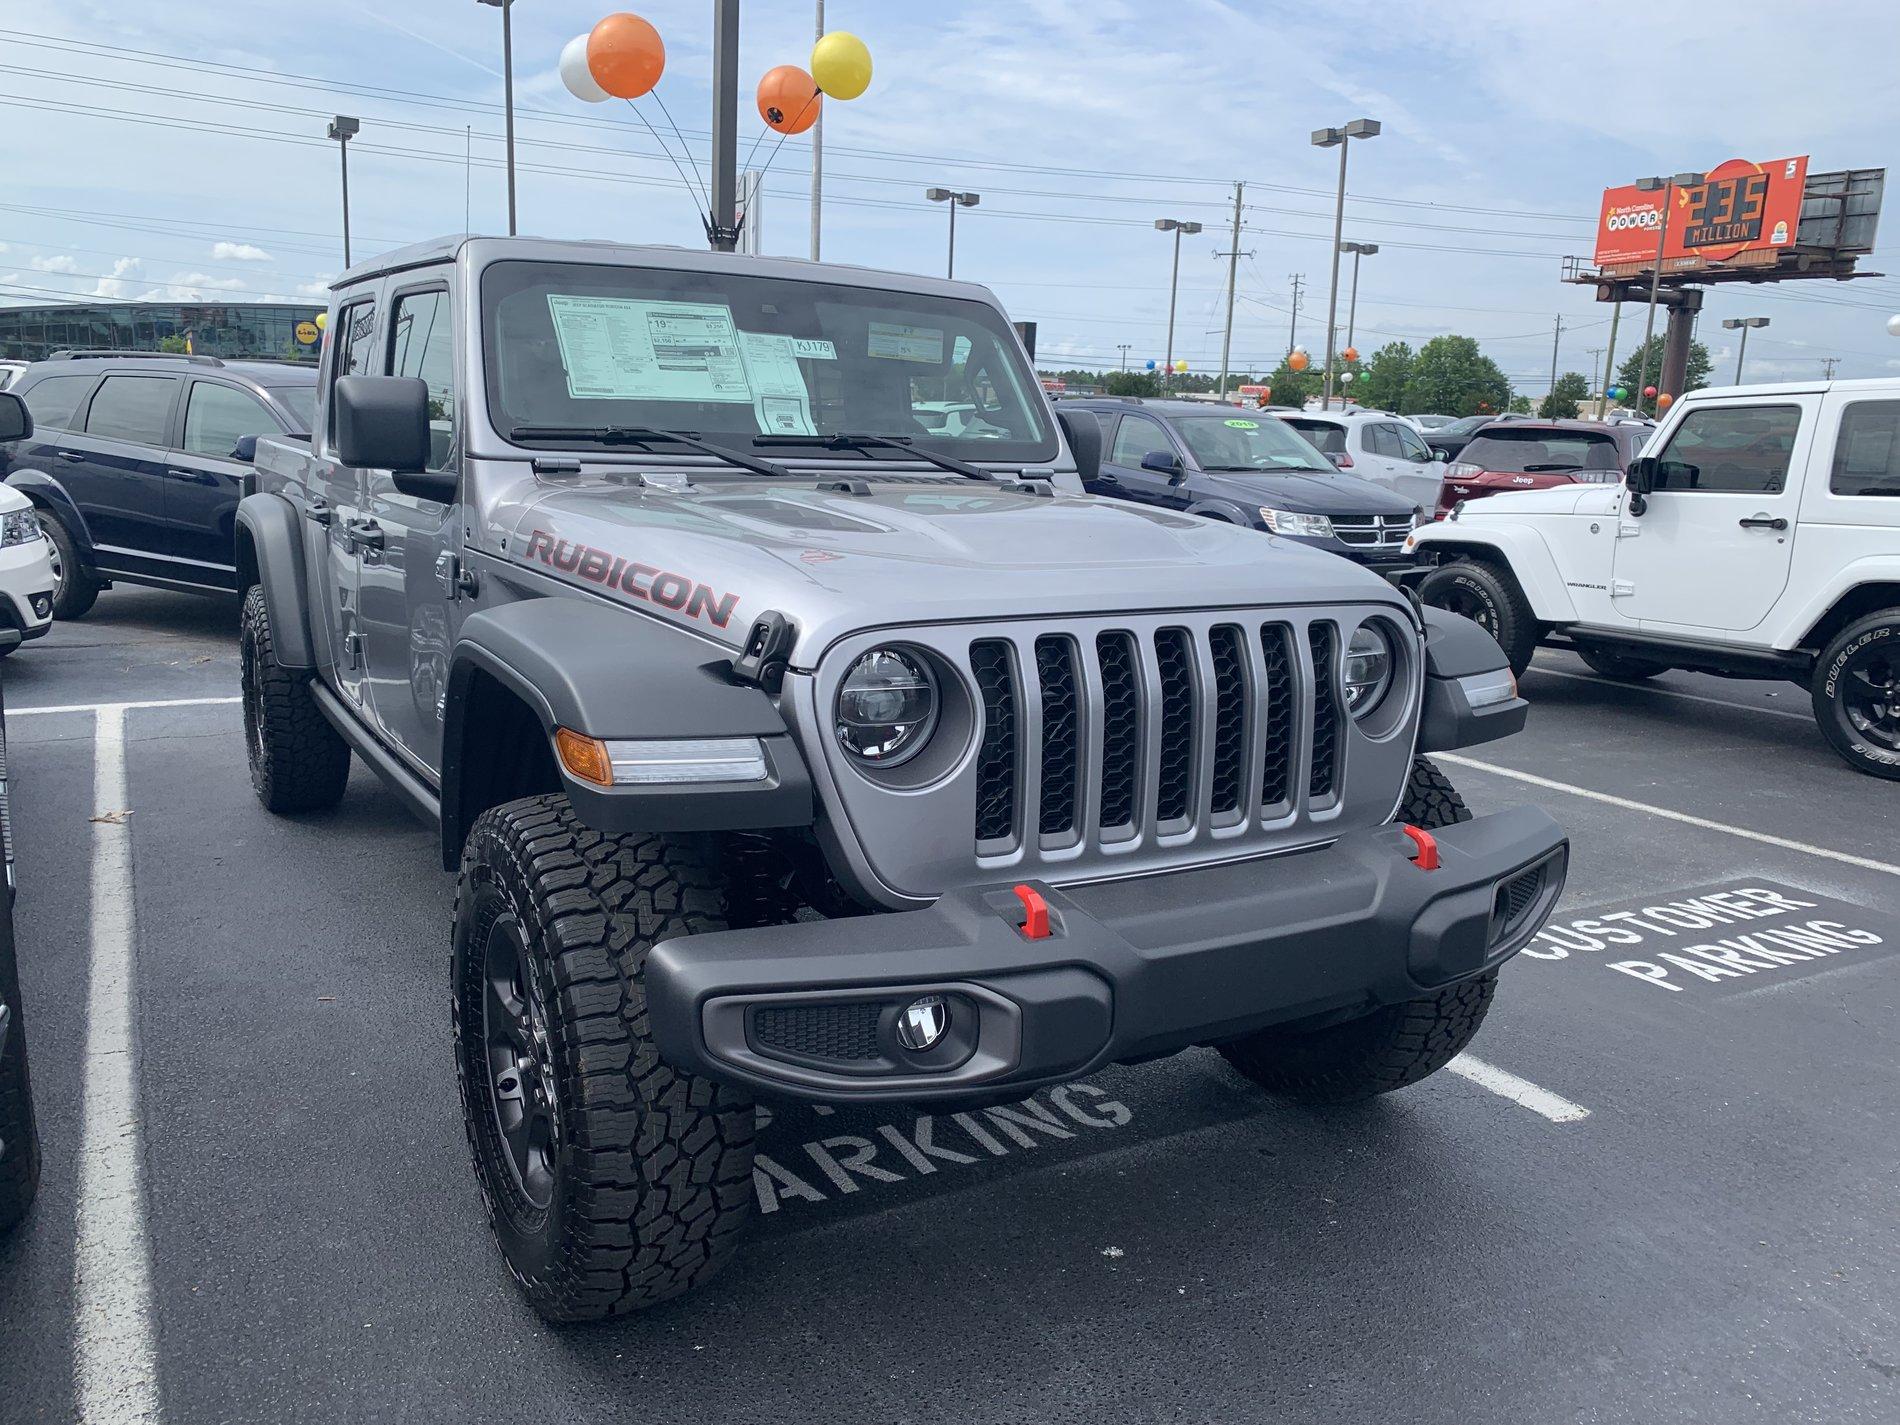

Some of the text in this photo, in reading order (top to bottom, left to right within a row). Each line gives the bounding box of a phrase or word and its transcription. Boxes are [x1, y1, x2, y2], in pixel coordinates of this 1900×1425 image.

[1610, 212, 1657, 229] POWER
[1693, 222, 1749, 243] MILLION
[654, 320, 666, 328] 19
[1512, 476, 1534, 485] Jeep
[526, 530, 741, 630] RUBICON
[1567, 582, 1607, 590] WRANGLER
[1826, 628, 1890, 699] DUELER
[1520, 888, 1818, 961] CUSTOMER
[1605, 920, 1884, 992] PARKING
[753, 1083, 1133, 1214] ARKING
